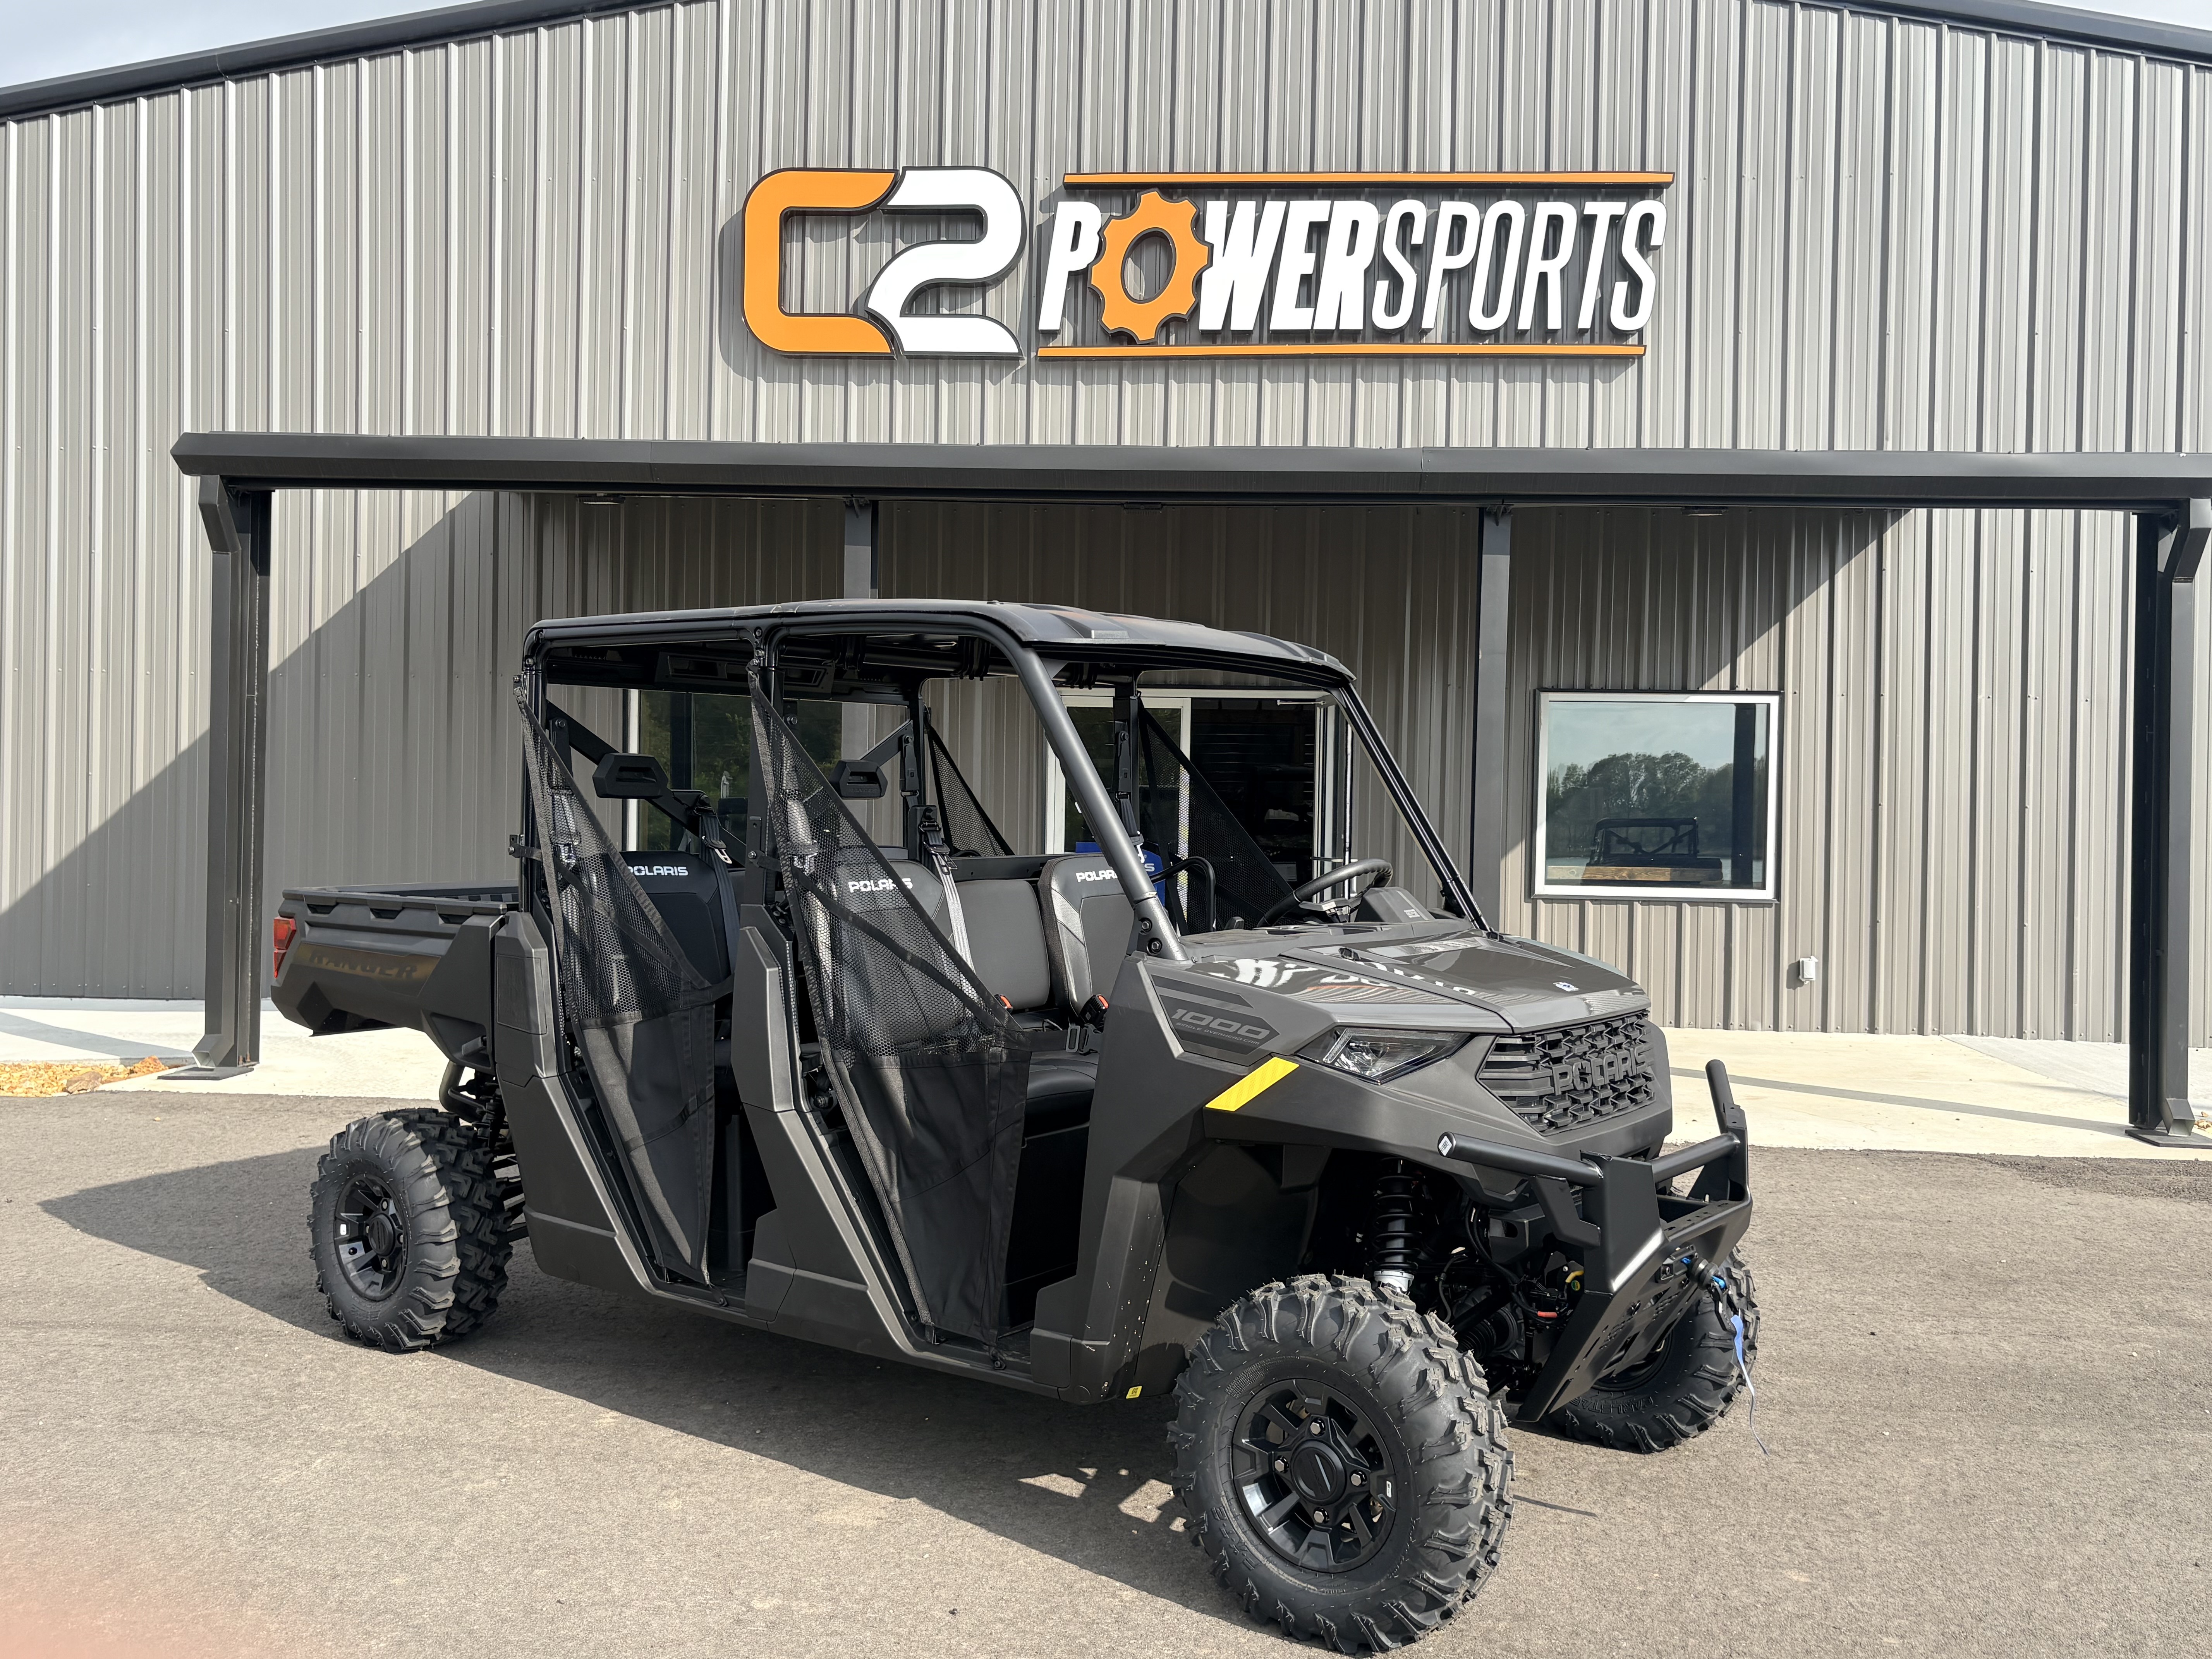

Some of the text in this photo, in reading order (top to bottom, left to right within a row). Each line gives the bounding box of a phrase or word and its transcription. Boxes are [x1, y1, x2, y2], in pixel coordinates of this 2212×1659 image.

[742, 167, 1668, 359] C2 POWERSPORTS
[848, 878, 913, 893] POLARS
[1075, 869, 1118, 883] POLAR
[1171, 1008, 1270, 1039] 1000
[1176, 1022, 1202, 1031] SINGLE
[1204, 1029, 1243, 1041] OVERHEAD
[1552, 1043, 1654, 1096] POLARIS
